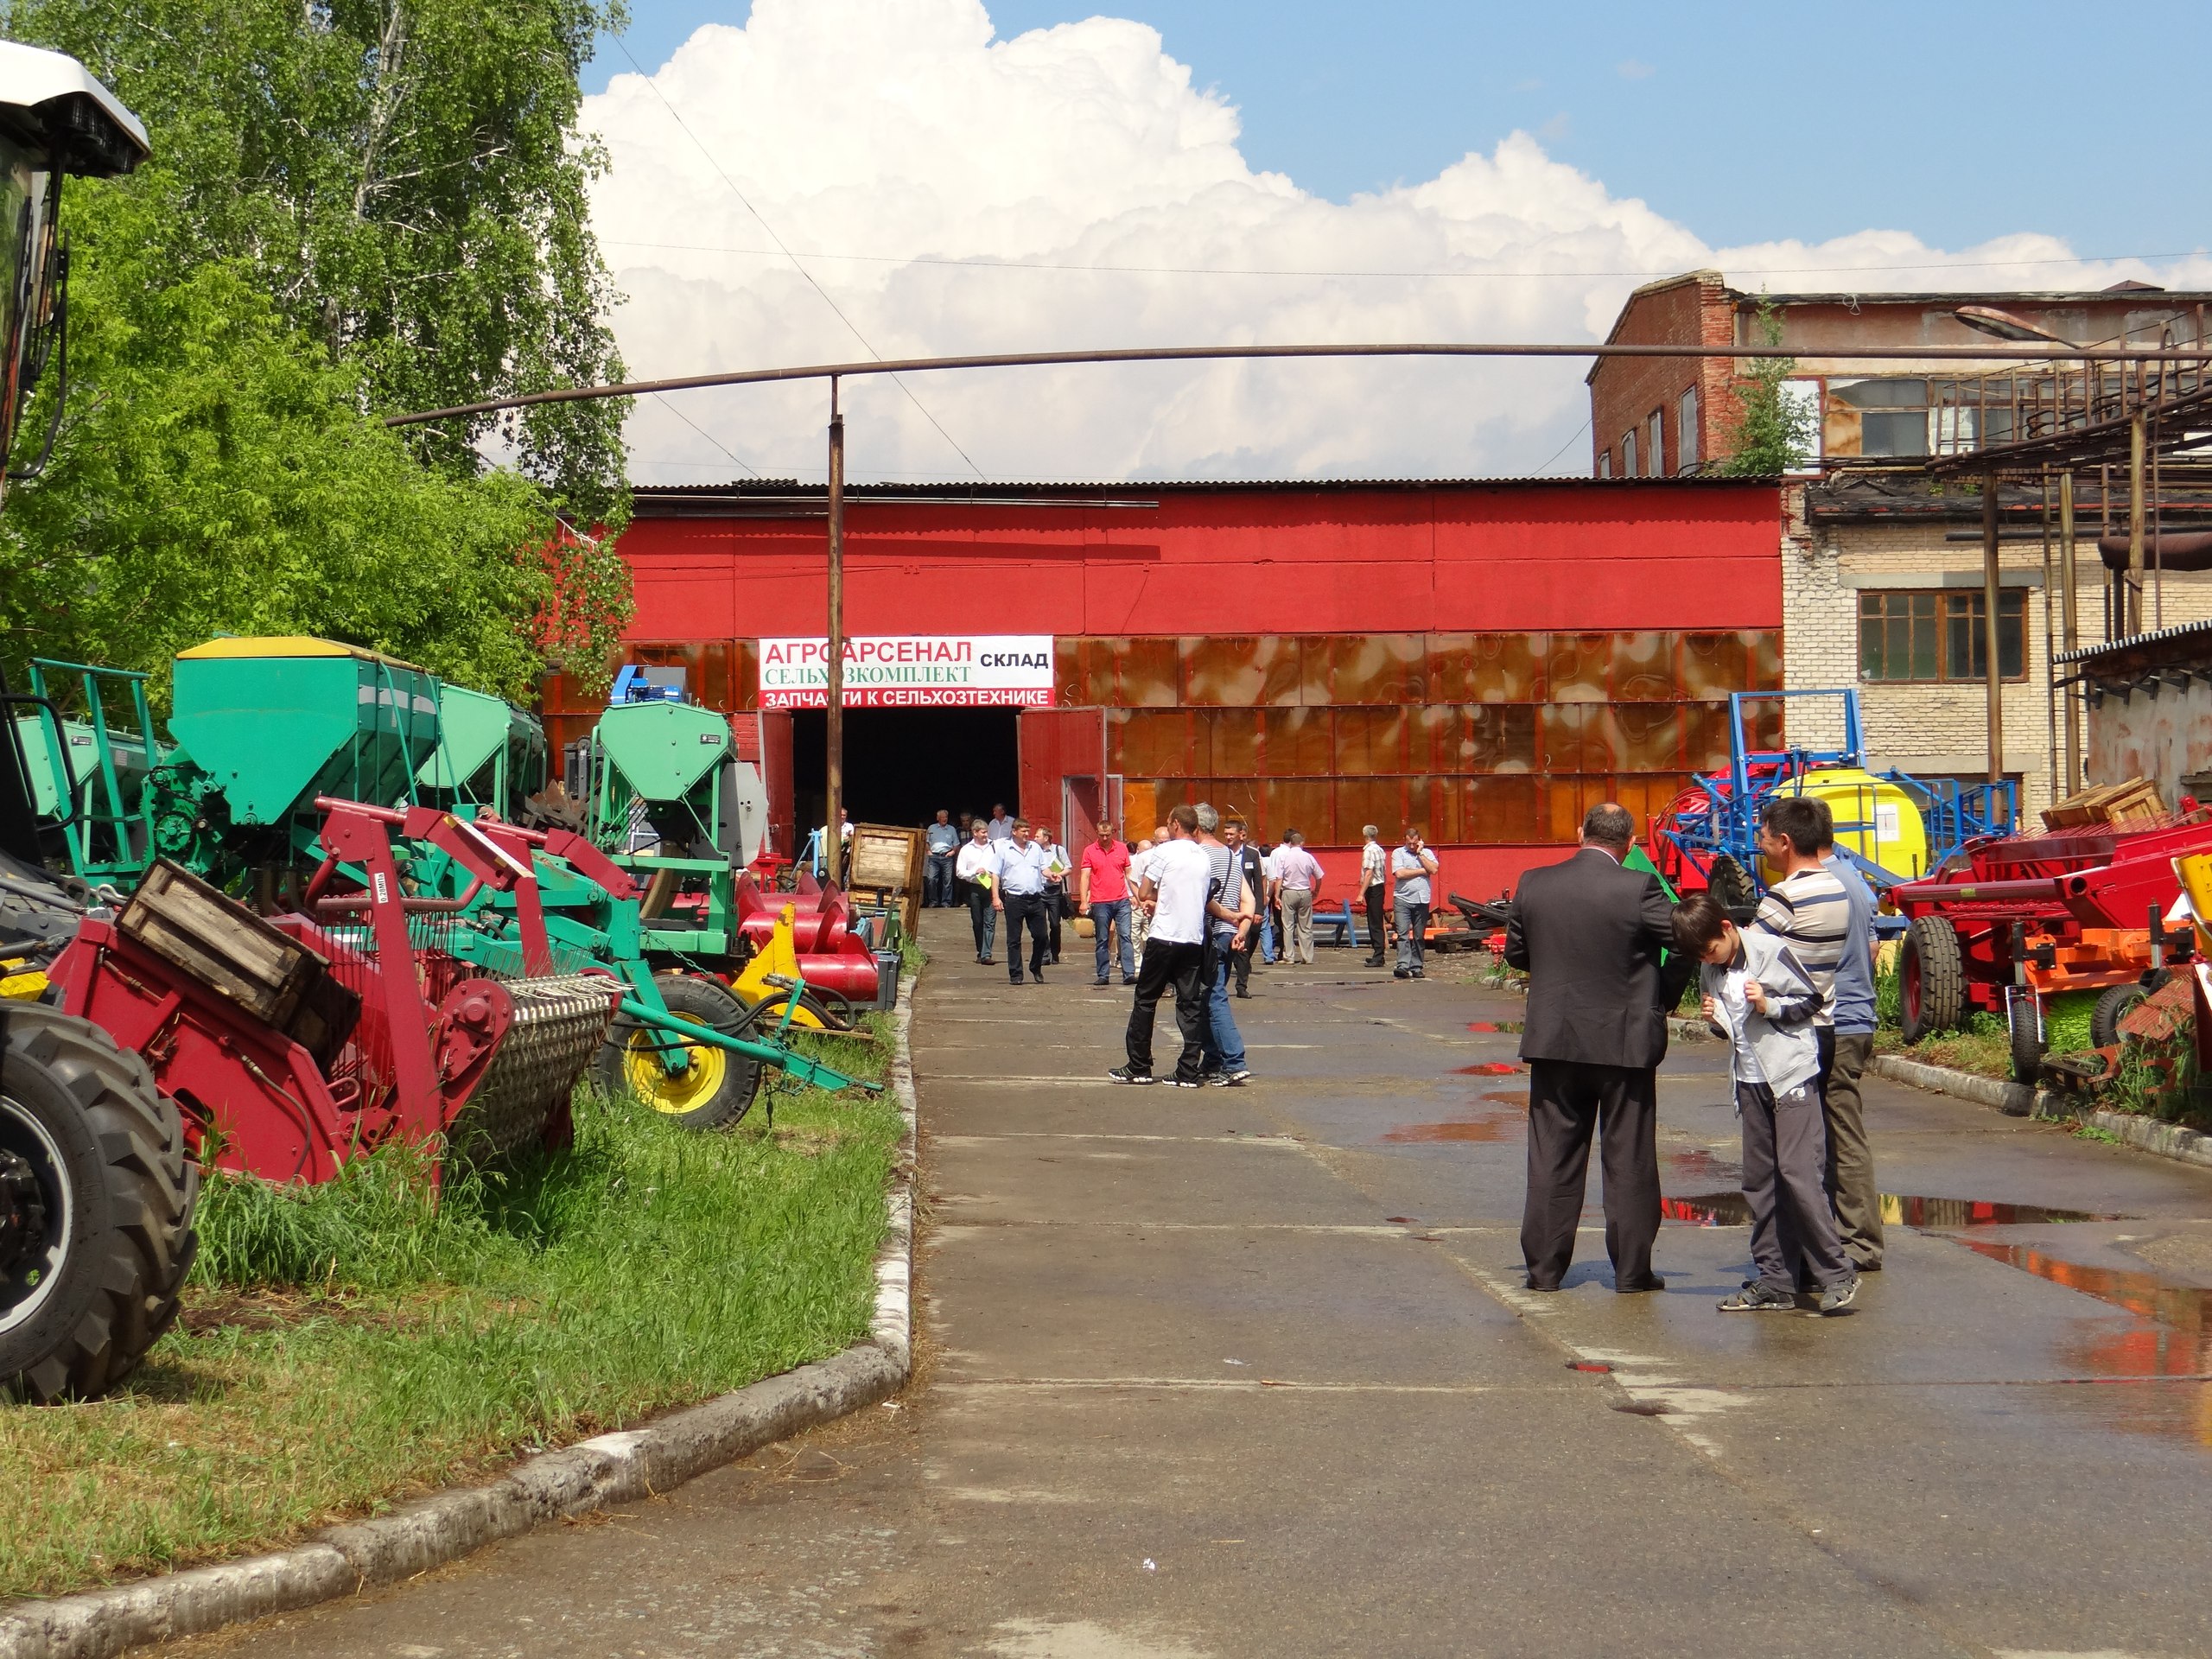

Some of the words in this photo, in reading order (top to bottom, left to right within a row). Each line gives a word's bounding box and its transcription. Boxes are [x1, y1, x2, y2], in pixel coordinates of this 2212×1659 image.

[980, 653, 1049, 670] СКЛАД
[765, 666, 972, 684] СЕЛЬХЗКОМПЛЕКТ
[765, 691, 861, 707] ЗАПЧАТИ
[868, 690, 879, 705] К
[883, 690, 1049, 705] СЕЛЬХОЗТЕХНИКЕ
